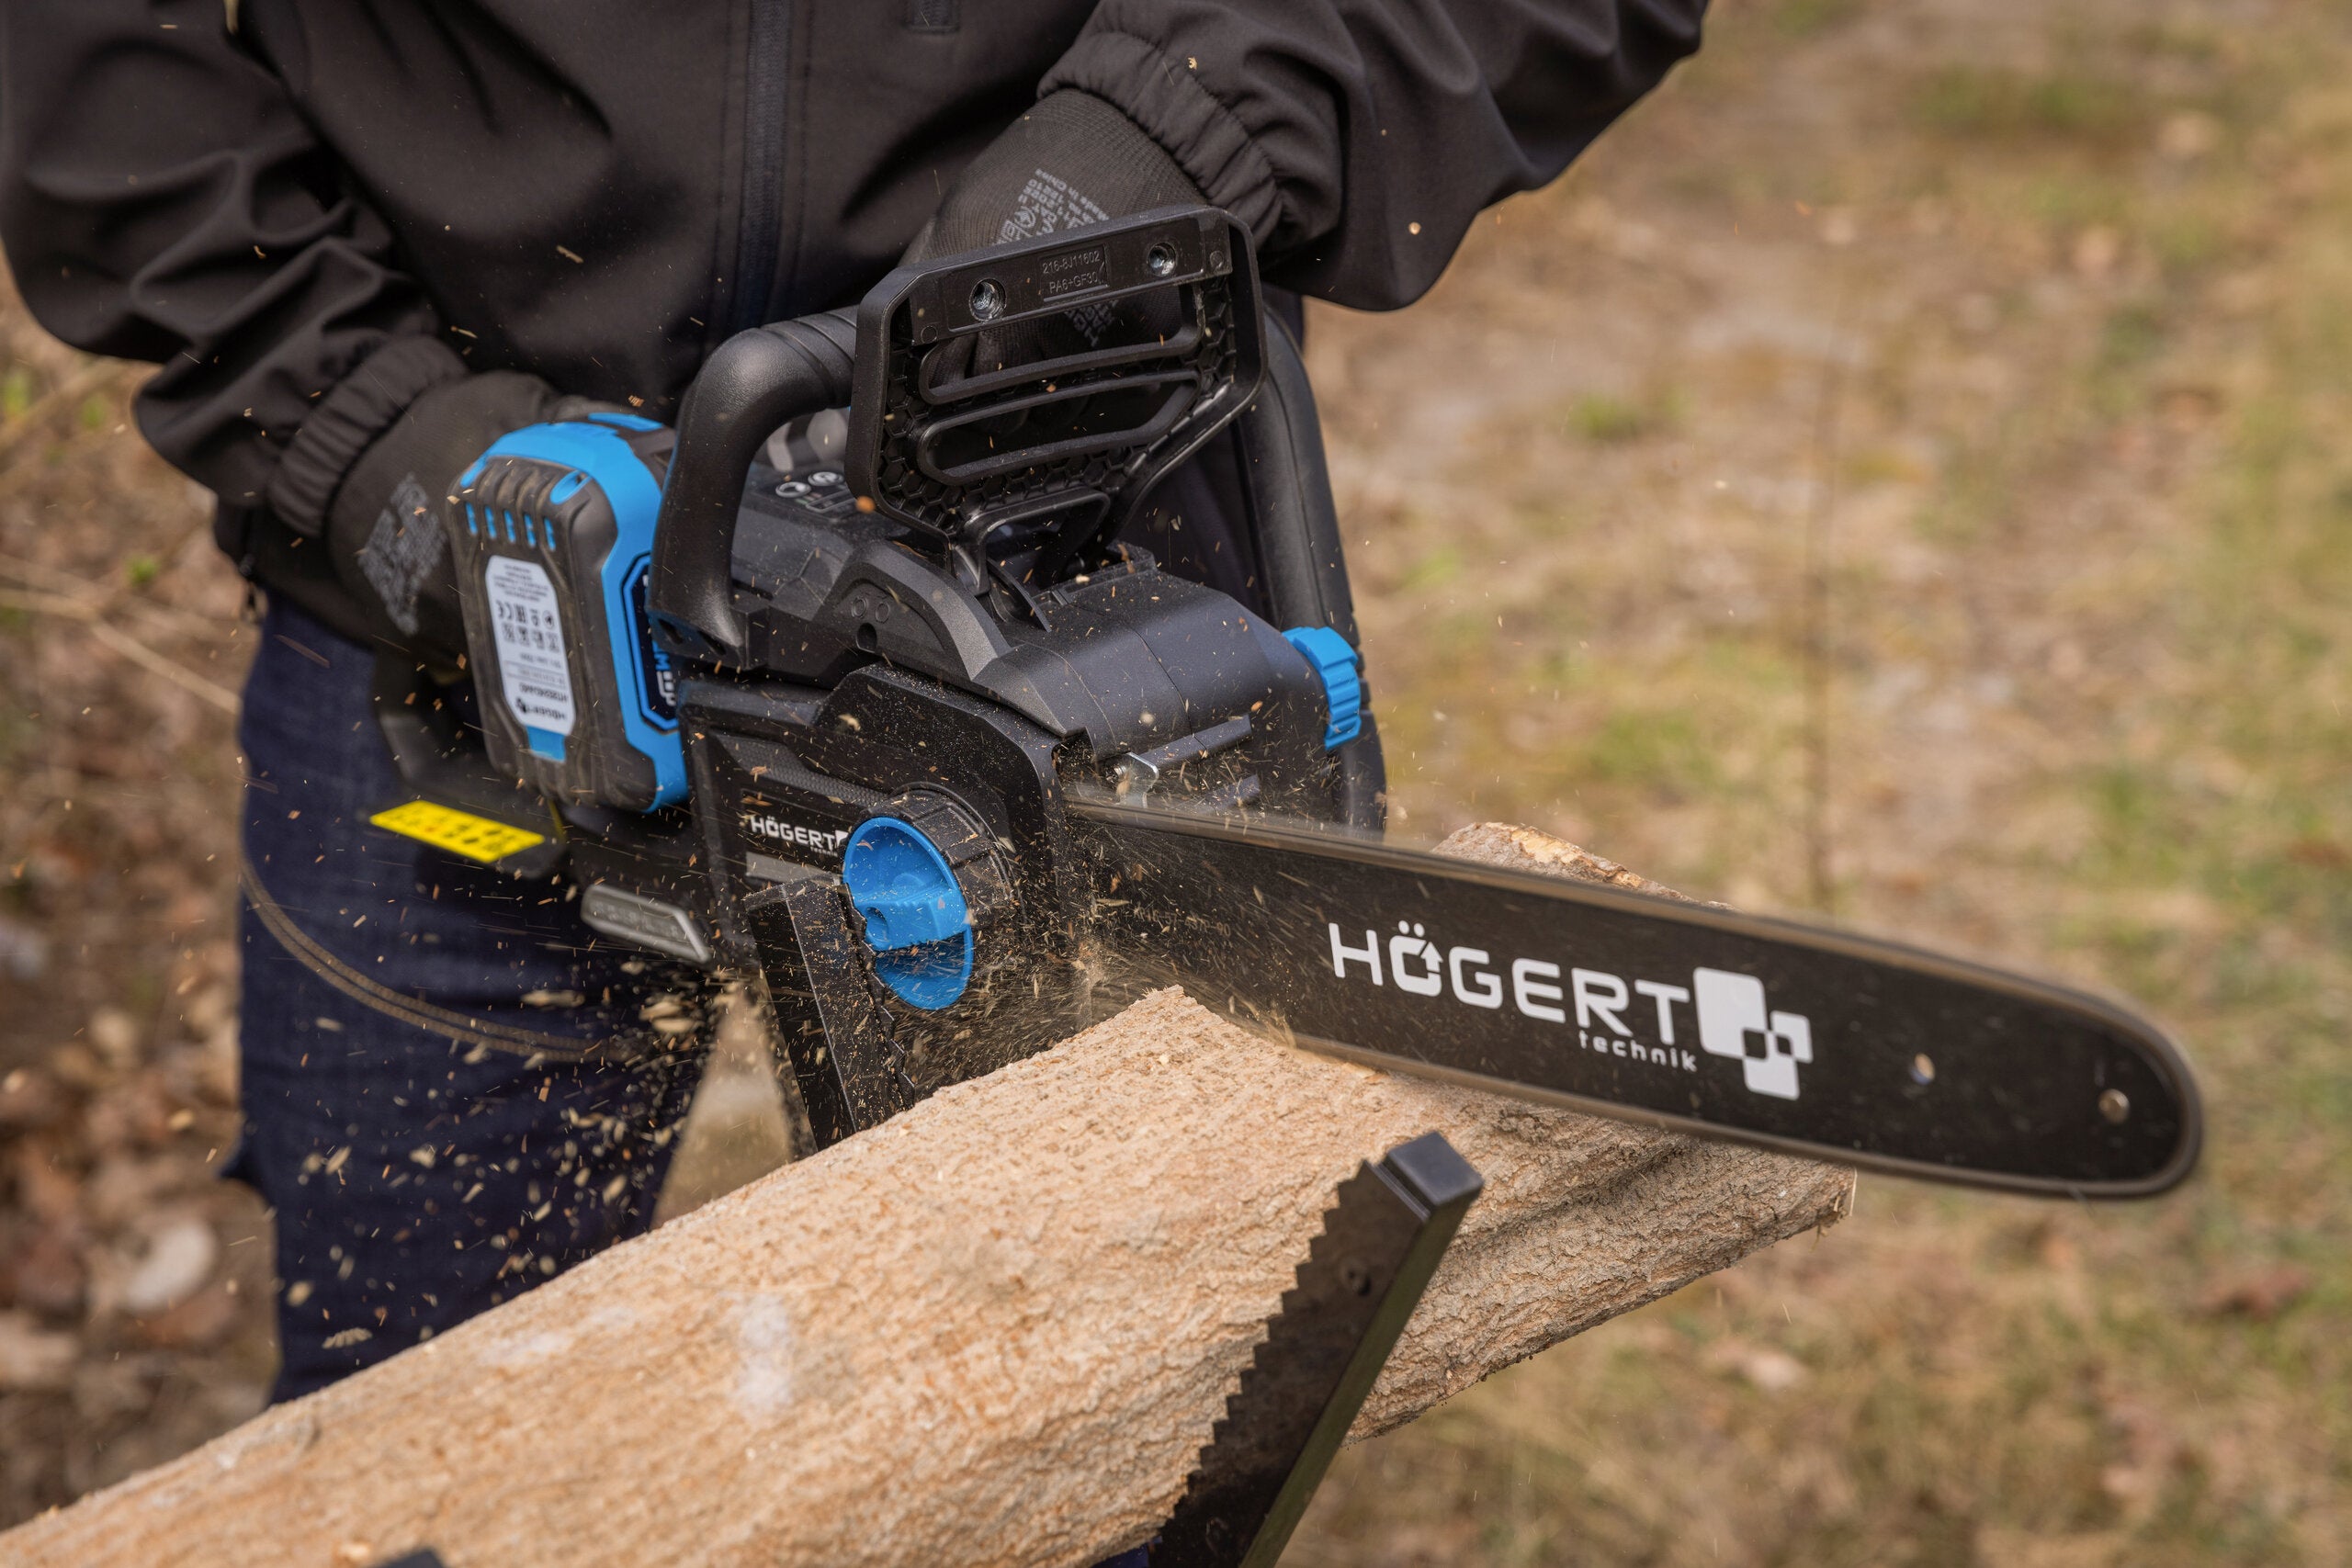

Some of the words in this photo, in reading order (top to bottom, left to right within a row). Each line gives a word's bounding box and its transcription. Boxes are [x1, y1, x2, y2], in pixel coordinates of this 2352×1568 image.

[1049, 271, 1098, 294] PA6+GF30
[750, 815, 835, 852] HÖGERT
[1328, 919, 1690, 1045] HÖGERT
[1578, 1030, 1698, 1073] technik
